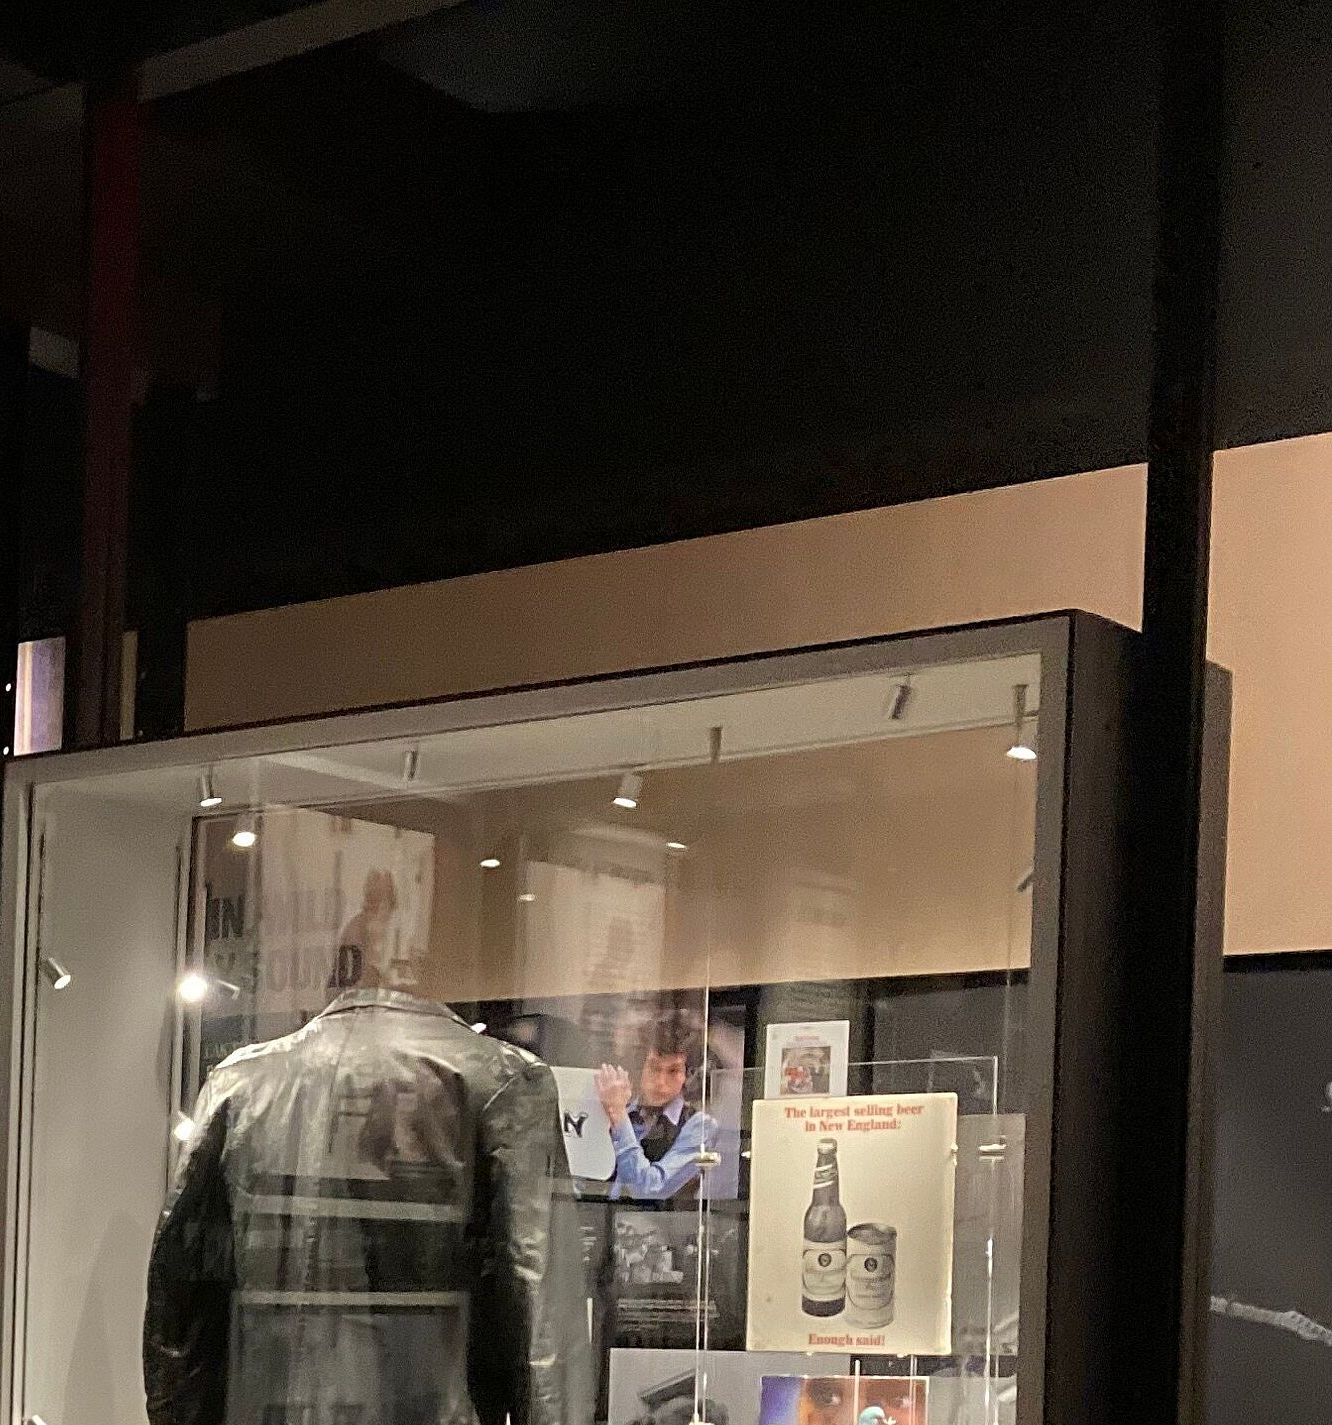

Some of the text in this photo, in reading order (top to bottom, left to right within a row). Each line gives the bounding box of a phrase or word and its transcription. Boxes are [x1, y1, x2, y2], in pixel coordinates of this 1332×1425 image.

[784, 1103, 925, 1119] The largest selling beer
[805, 1120, 816, 1132] in
[819, 1120, 843, 1132] New
[808, 1333, 854, 1346] Enough
